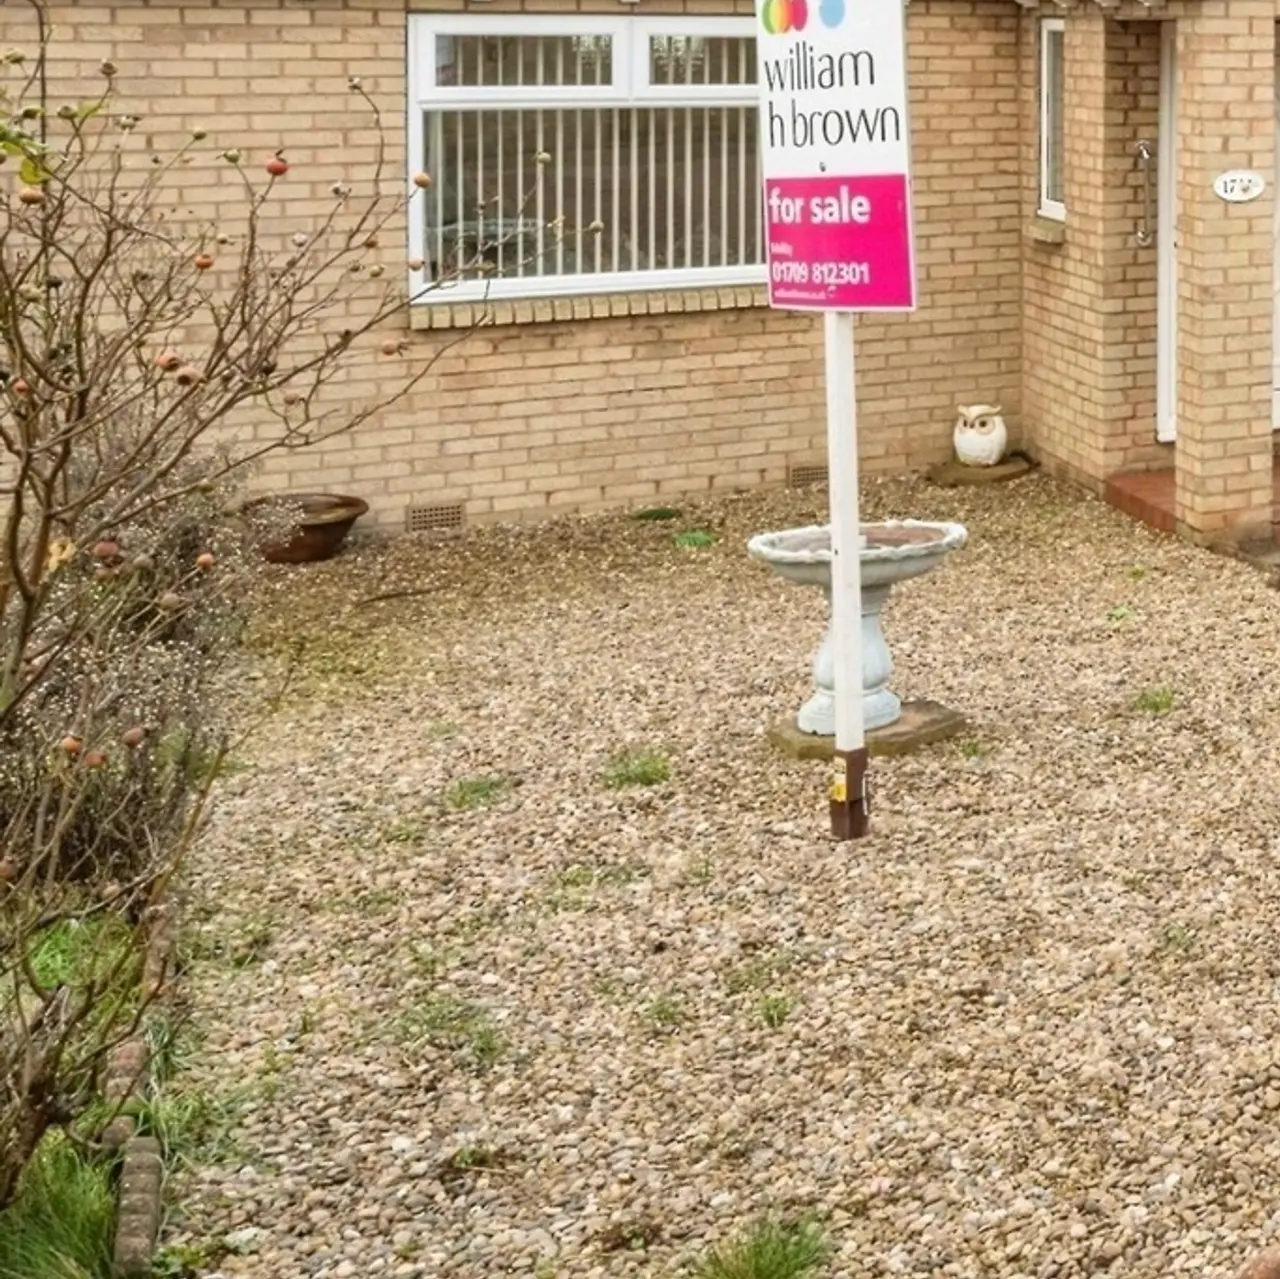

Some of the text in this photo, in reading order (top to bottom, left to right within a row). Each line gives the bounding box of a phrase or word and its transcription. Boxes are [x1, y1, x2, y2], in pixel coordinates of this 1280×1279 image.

[764, 40, 875, 91] william
[769, 98, 900, 148] h brown
[768, 184, 871, 224] for sale
[811, 261, 870, 285] 812301
